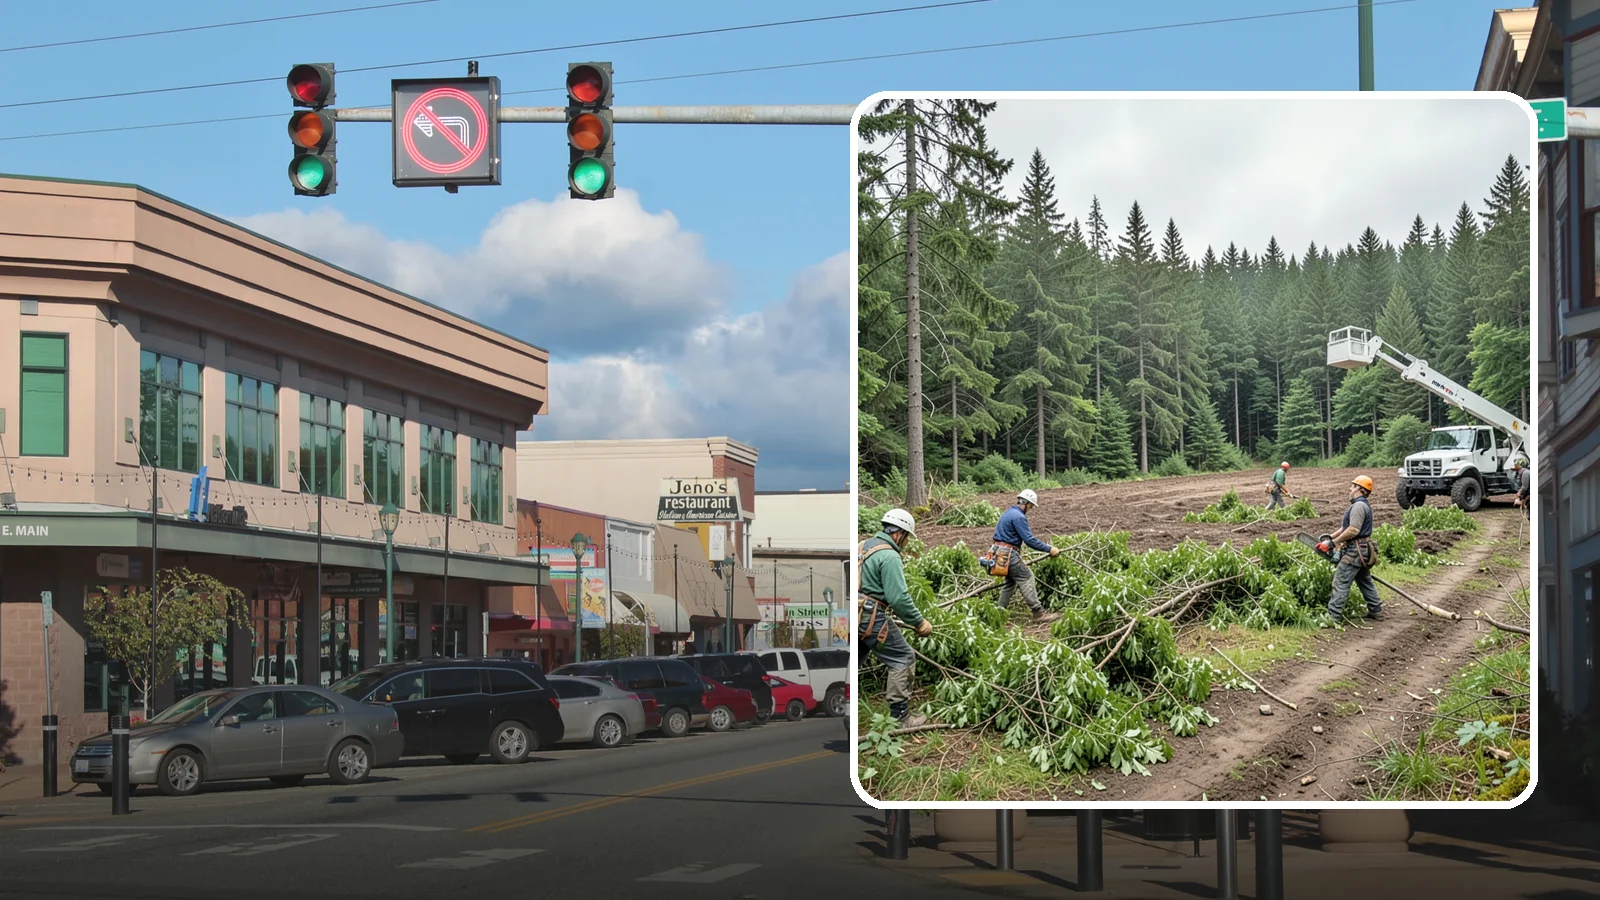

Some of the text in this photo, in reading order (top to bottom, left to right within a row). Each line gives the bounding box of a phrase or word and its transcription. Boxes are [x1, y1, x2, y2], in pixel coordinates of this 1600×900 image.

[670, 480, 727, 494] Jeno's
[665, 496, 731, 509] restaurant
[658, 510, 681, 519] Italian
[686, 510, 714, 519] American
[715, 509, 737, 519] Cuisine
[2, 525, 49, 536] E. MAIN
[797, 607, 828, 617] Street
